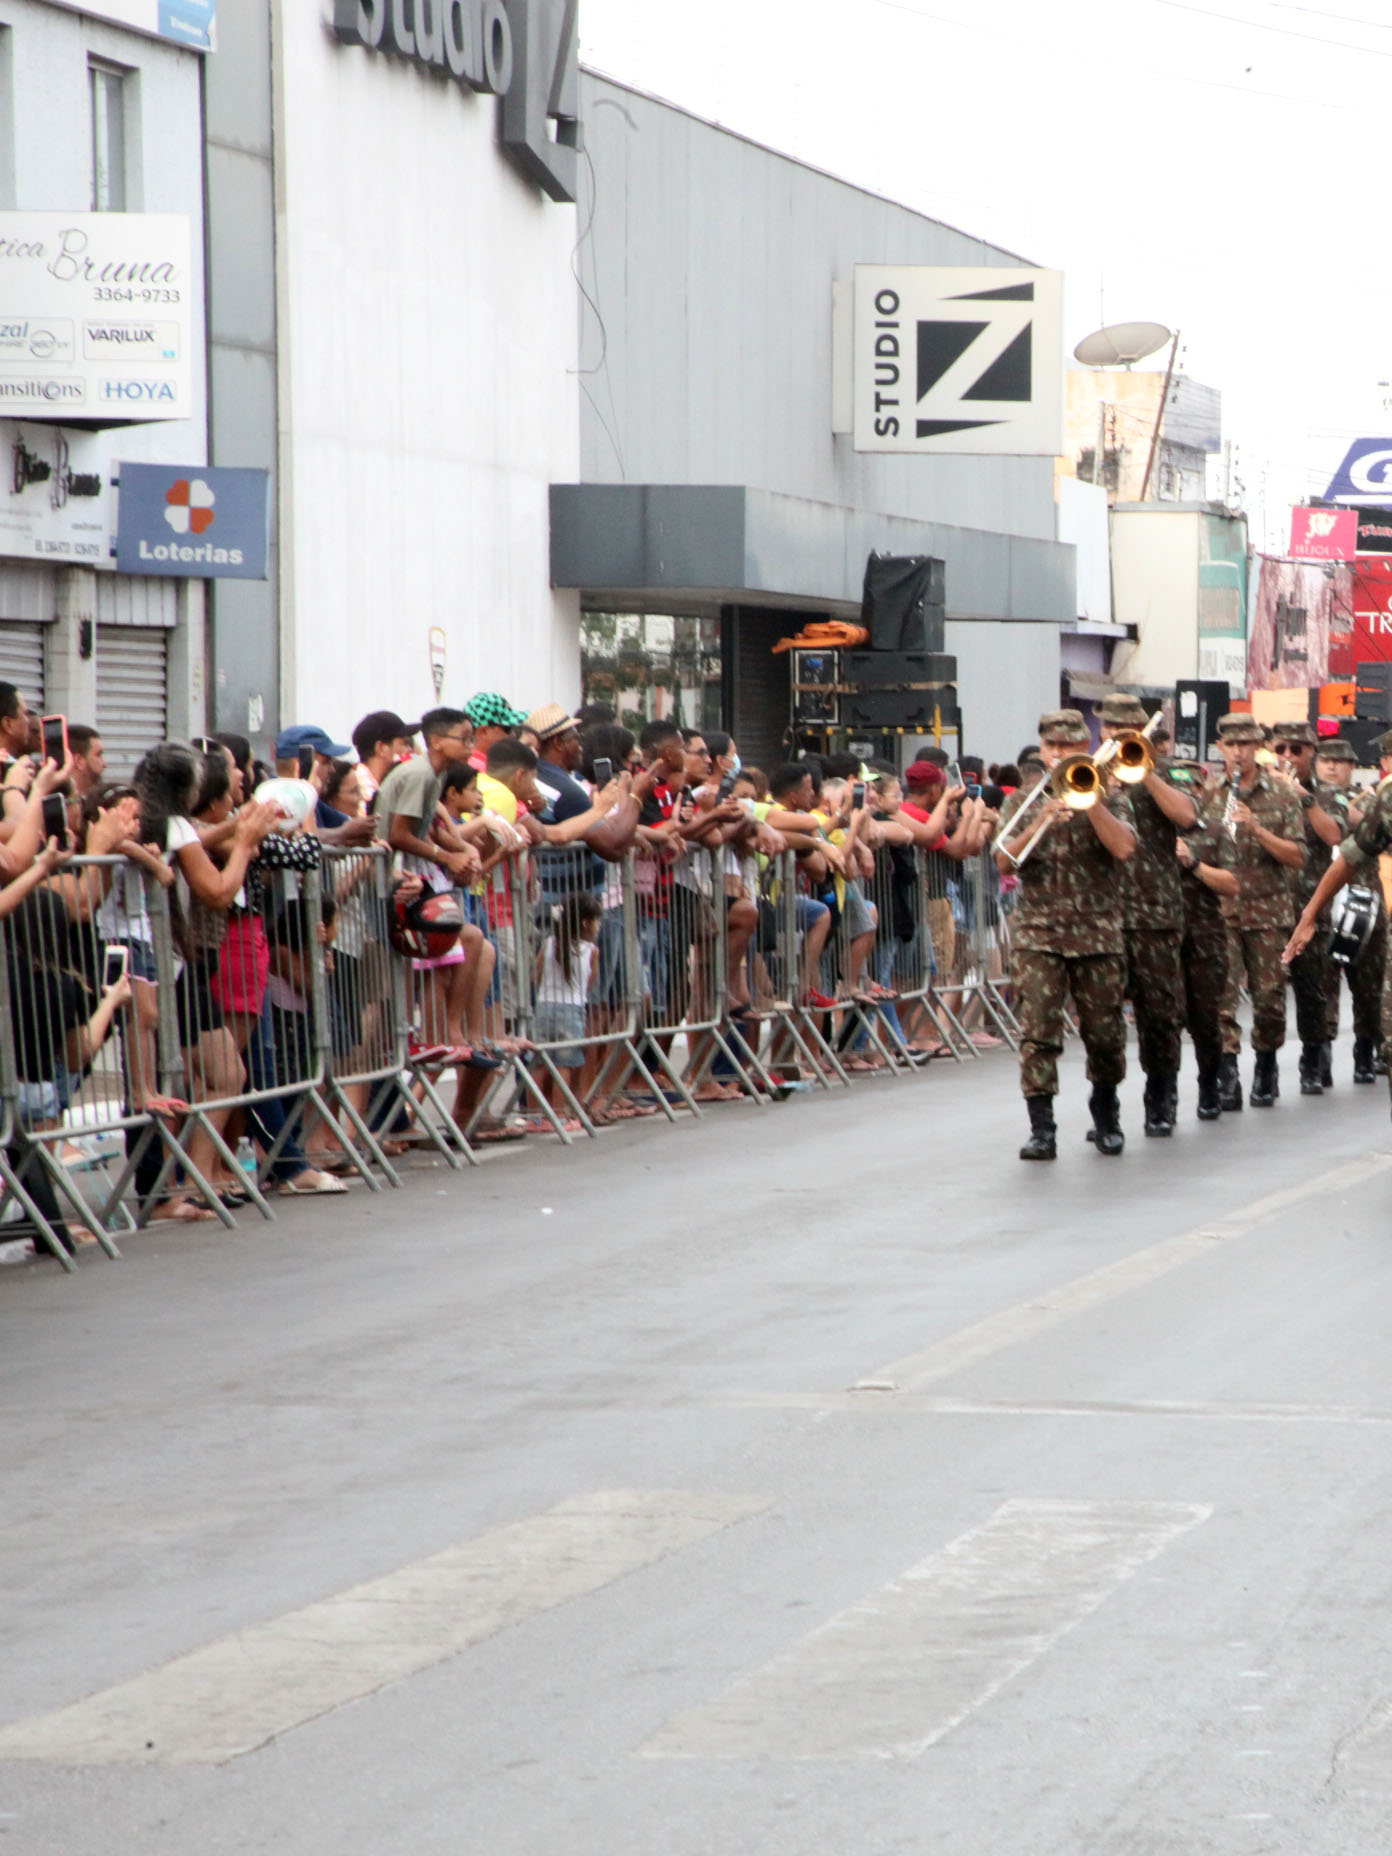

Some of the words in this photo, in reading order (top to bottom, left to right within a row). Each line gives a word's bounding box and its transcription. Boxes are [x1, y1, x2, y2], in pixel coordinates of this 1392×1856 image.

[0, 237, 46, 258] ica
[46, 228, 178, 283] Bruna
[93, 286, 181, 303] 3364-9733
[87, 328, 156, 344] VARILUX
[873, 288, 900, 438] STUDIO
[105, 381, 175, 400] HOYA
[138, 539, 244, 565] Loterias
